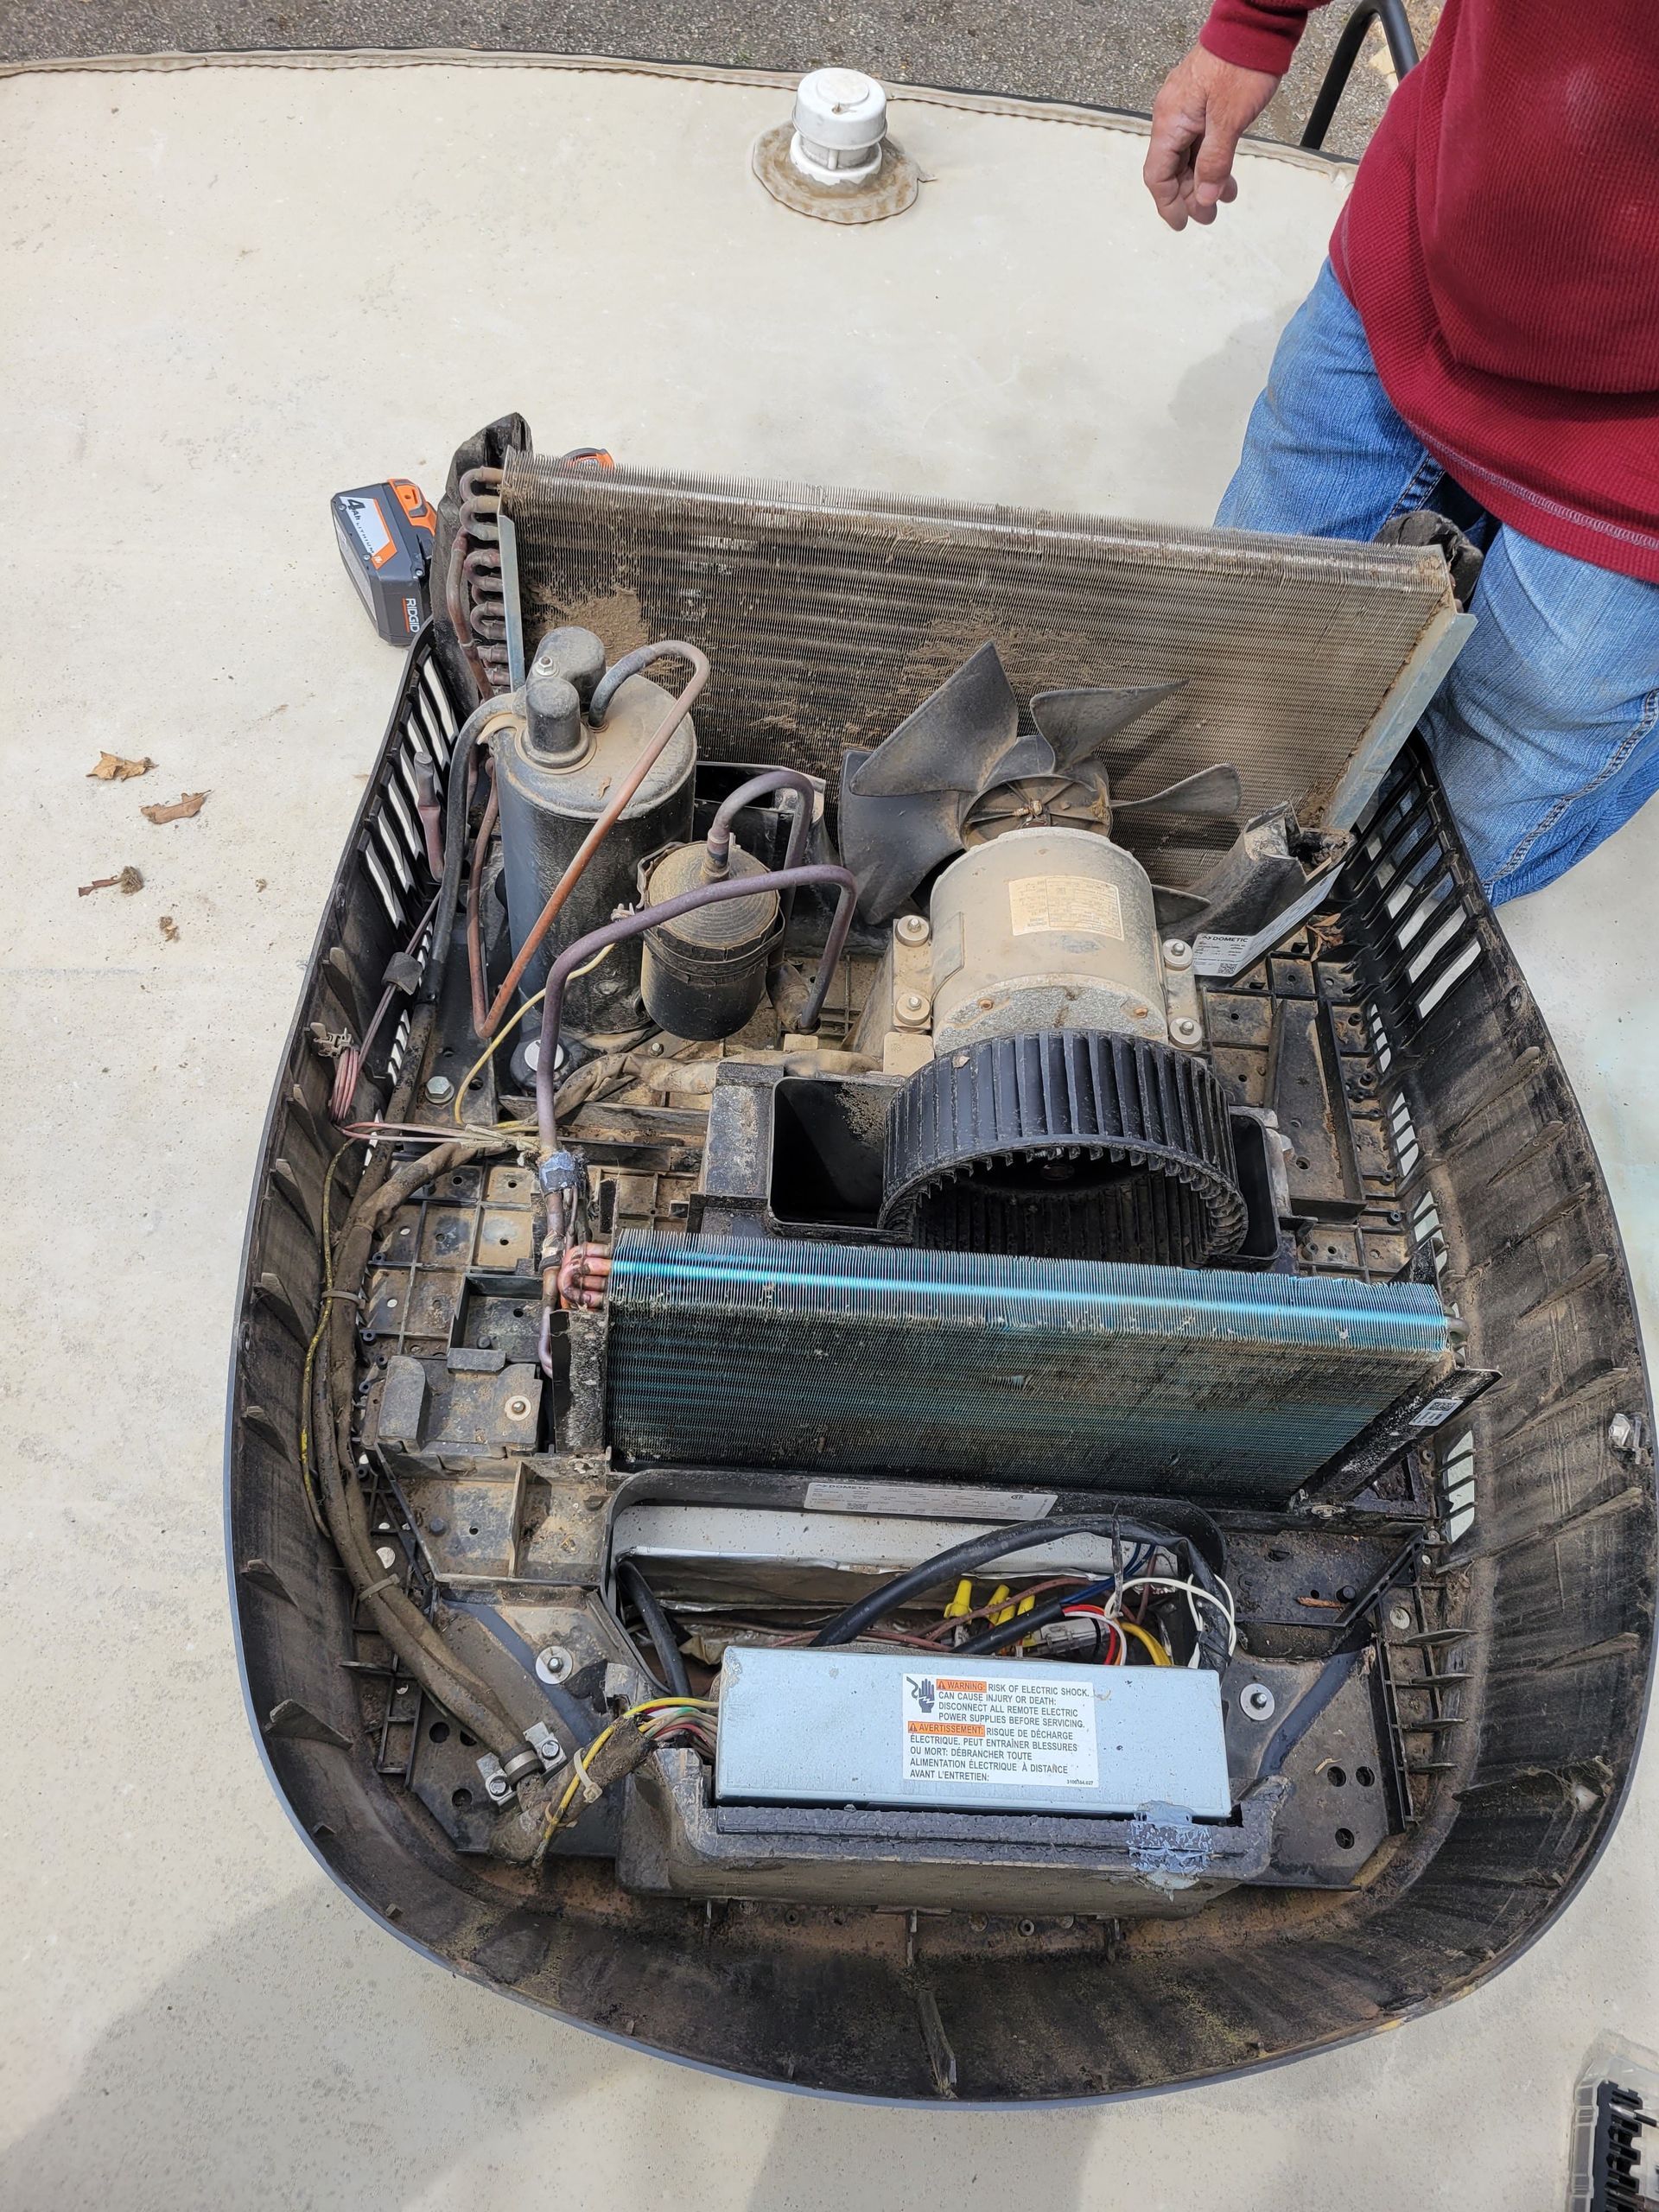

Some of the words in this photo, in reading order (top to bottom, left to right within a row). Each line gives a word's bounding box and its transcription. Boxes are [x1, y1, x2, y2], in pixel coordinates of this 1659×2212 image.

[406, 598, 420, 633] RIDGID
[947, 1681, 985, 1691] WARNING:
[988, 1684, 1006, 1692] RISK
[1008, 1684, 1018, 1693] OF
[1022, 1685, 1058, 1695] ELECTRIC
[1061, 1688, 1089, 1697] SHOCK.
[939, 1691, 954, 1700] CAN
[957, 1693, 983, 1701] CAUSE
[986, 1694, 1012, 1703] INJURY
[1016, 1695, 1026, 1703] OR
[1029, 1696, 1056, 1705] DEATH:
[939, 1702, 987, 1712] DISCONNECT
[990, 1705, 1004, 1713] ALL
[1007, 1706, 1039, 1715] REMOTE
[1041, 1707, 1078, 1717] ELECTRIC
[939, 1713, 966, 1721] POWER
[970, 1714, 1006, 1723] SUPPLIES
[1009, 1716, 1040, 1725] BEFORE
[1042, 1718, 1085, 1728] SERVICING.
[919, 1724, 984, 1734] AVERTISSEMENT:
[987, 1728, 1015, 1737] RISQUE
[1018, 1729, 1028, 1737] DE
[1031, 1729, 1073, 1740] DÉCHARGE
[910, 1733, 960, 1745] ÉLECTRIQUE.
[963, 1738, 983, 1746] PEUT
[986, 1738, 1029, 1749] ENTRAÎNER
[1033, 1741, 1078, 1751] BLESSURES
[910, 1746, 921, 1754] OU
[925, 1747, 948, 1756] MORT:
[951, 1747, 1004, 1759] DÉBRANCHER
[1007, 1751, 1032, 1760] TOUTE
[910, 1758, 966, 1768] ALIMENTATION
[969, 1758, 1017, 1771] ÉLECTRIQUE
[1022, 1762, 1028, 1772] À
[1031, 1764, 1068, 1774] DISTANCE
[910, 1769, 935, 1778] AVANT
[938, 1771, 989, 1781] L'ENTRETIEN:
